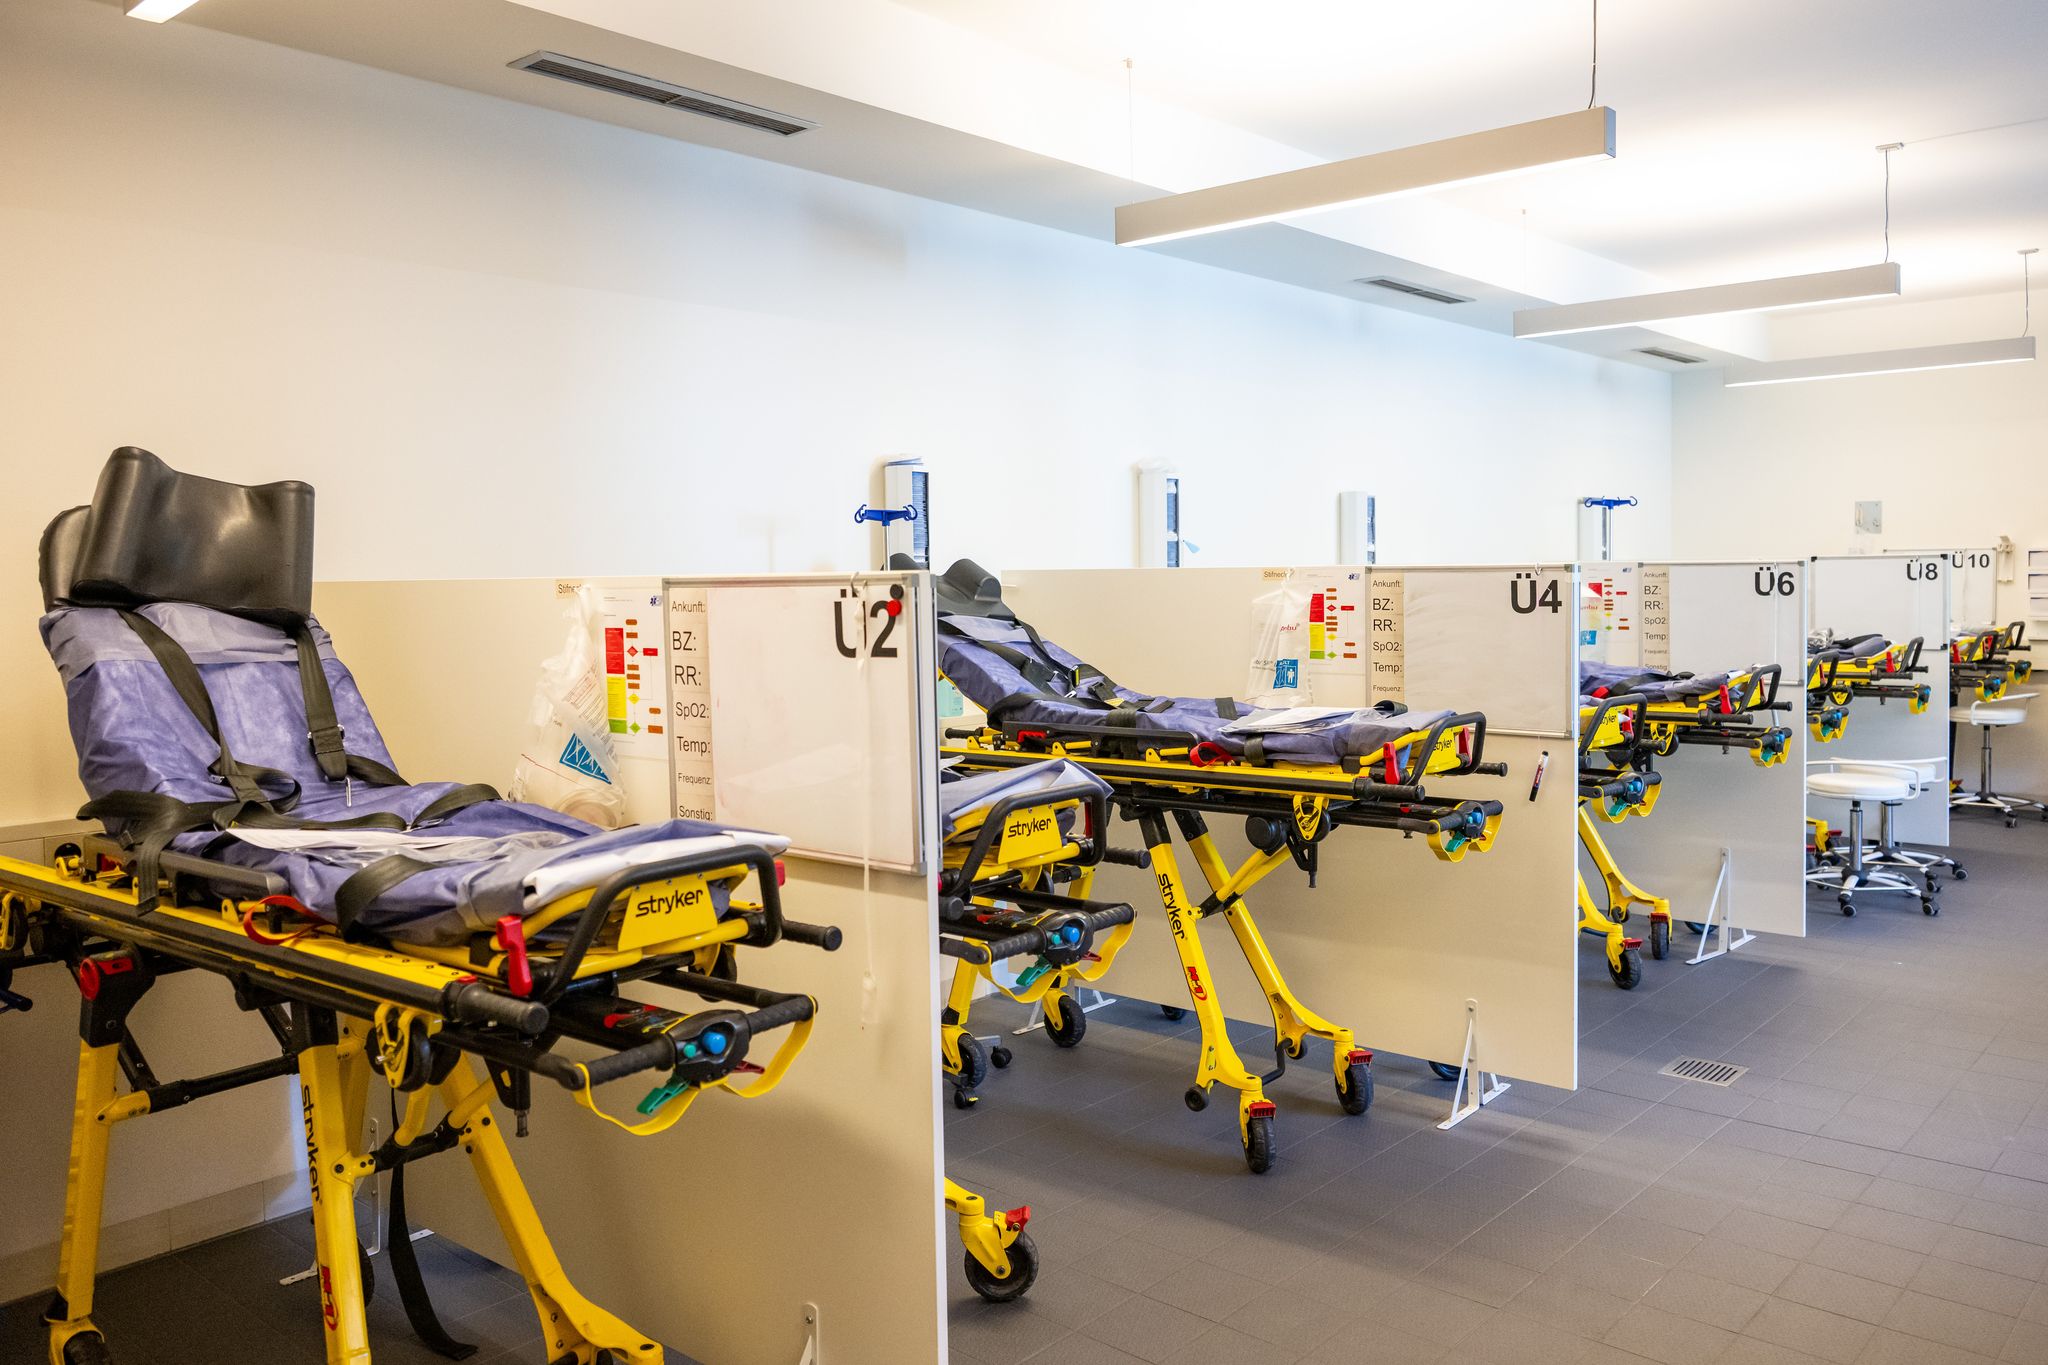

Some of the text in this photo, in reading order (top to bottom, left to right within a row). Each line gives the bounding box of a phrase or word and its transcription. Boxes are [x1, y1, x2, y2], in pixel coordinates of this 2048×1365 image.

[1906, 559, 1938, 581] Ü8
[1644, 586, 1662, 595] BZ:
[1755, 566, 1795, 596] Ü6
[1511, 573, 1562, 614] Ü4
[671, 601, 706, 613] Ankunft:
[1373, 598, 1394, 611] BZ:
[1644, 601, 1664, 610] RR:
[833, 589, 898, 659] Ü2
[1373, 619, 1396, 631] RR:
[672, 630, 697, 651] BZ:
[1373, 641, 1402, 652] SpO2:
[674, 665, 701, 686] RR:
[1373, 662, 1403, 674] Temp:
[675, 702, 710, 720] SpO2:
[676, 736, 711, 757] Temp:
[1007, 817, 1052, 838] stryker
[635, 889, 703, 917] stryker
[1158, 873, 1185, 939] stryker
[302, 1085, 320, 1202] stryker
